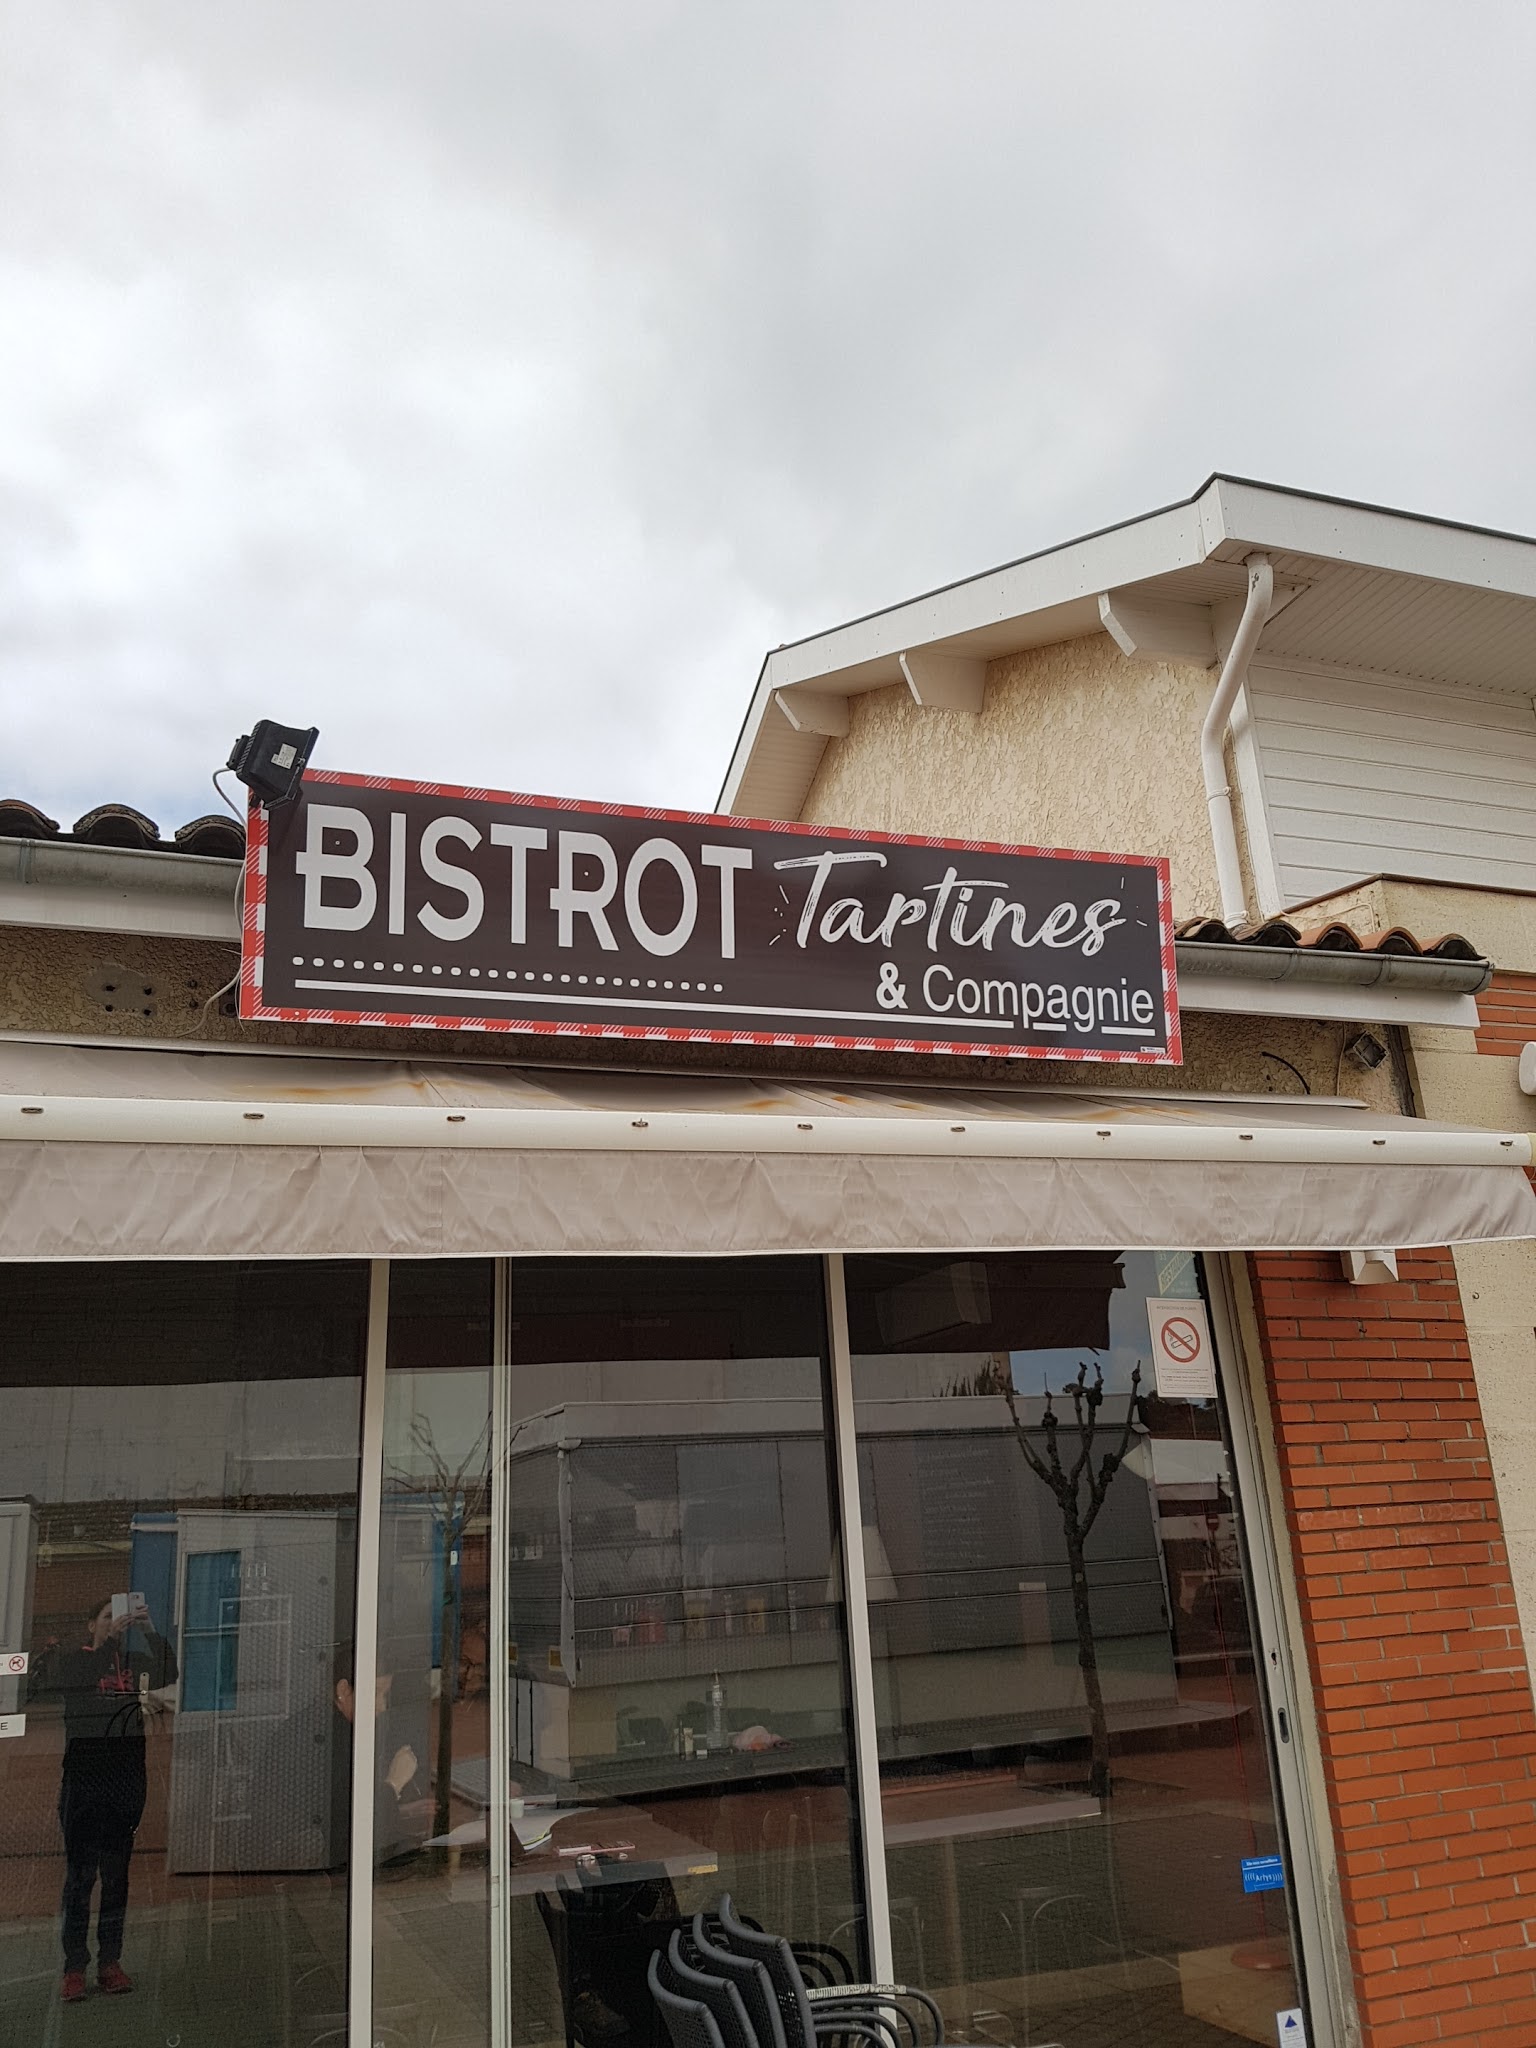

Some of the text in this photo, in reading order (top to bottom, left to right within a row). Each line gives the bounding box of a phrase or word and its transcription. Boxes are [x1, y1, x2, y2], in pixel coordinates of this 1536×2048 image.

[296, 803, 1127, 959] BISTROT Tartines
[876, 962, 1155, 1033] & Compagnie
